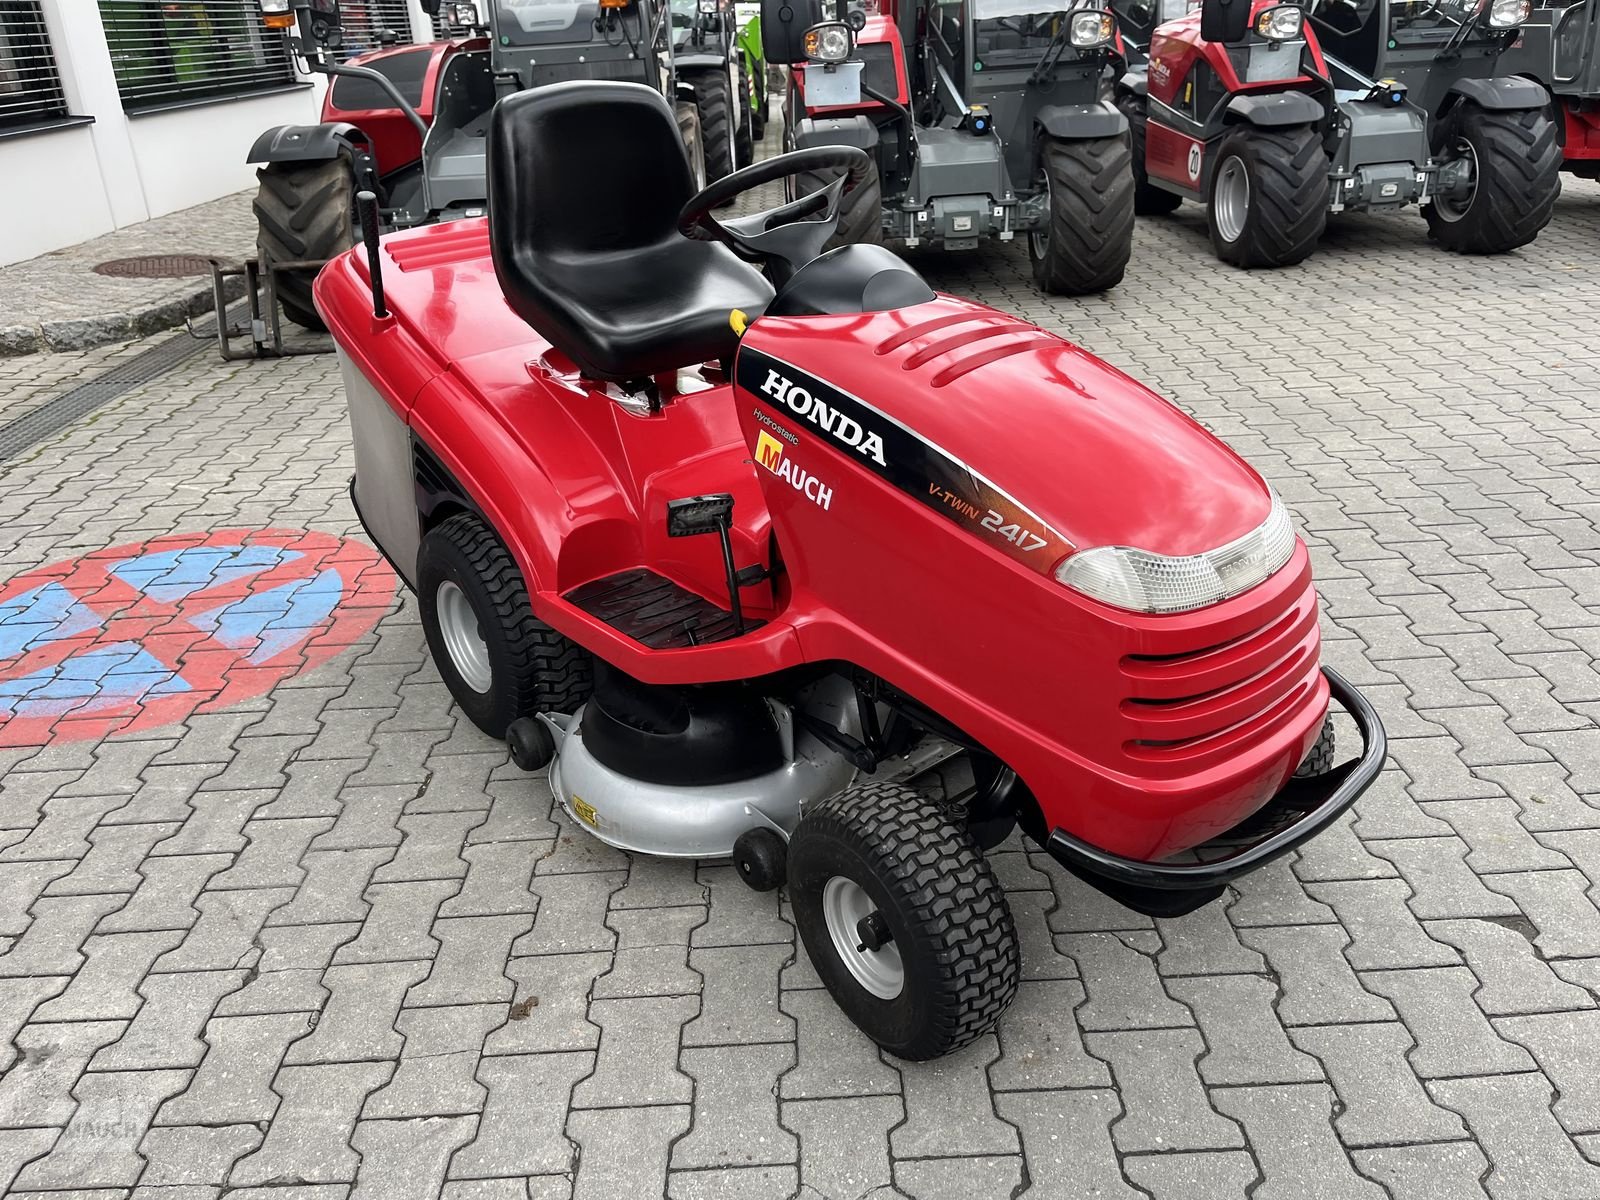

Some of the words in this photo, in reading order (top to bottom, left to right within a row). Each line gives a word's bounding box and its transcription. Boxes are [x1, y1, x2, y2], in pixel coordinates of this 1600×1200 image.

[753, 407, 799, 446] Hydrostatic
[760, 368, 888, 467] HONDA
[760, 443, 833, 511] MAUCH
[928, 482, 979, 520] V-TWIN
[980, 509, 1048, 551] 2417
